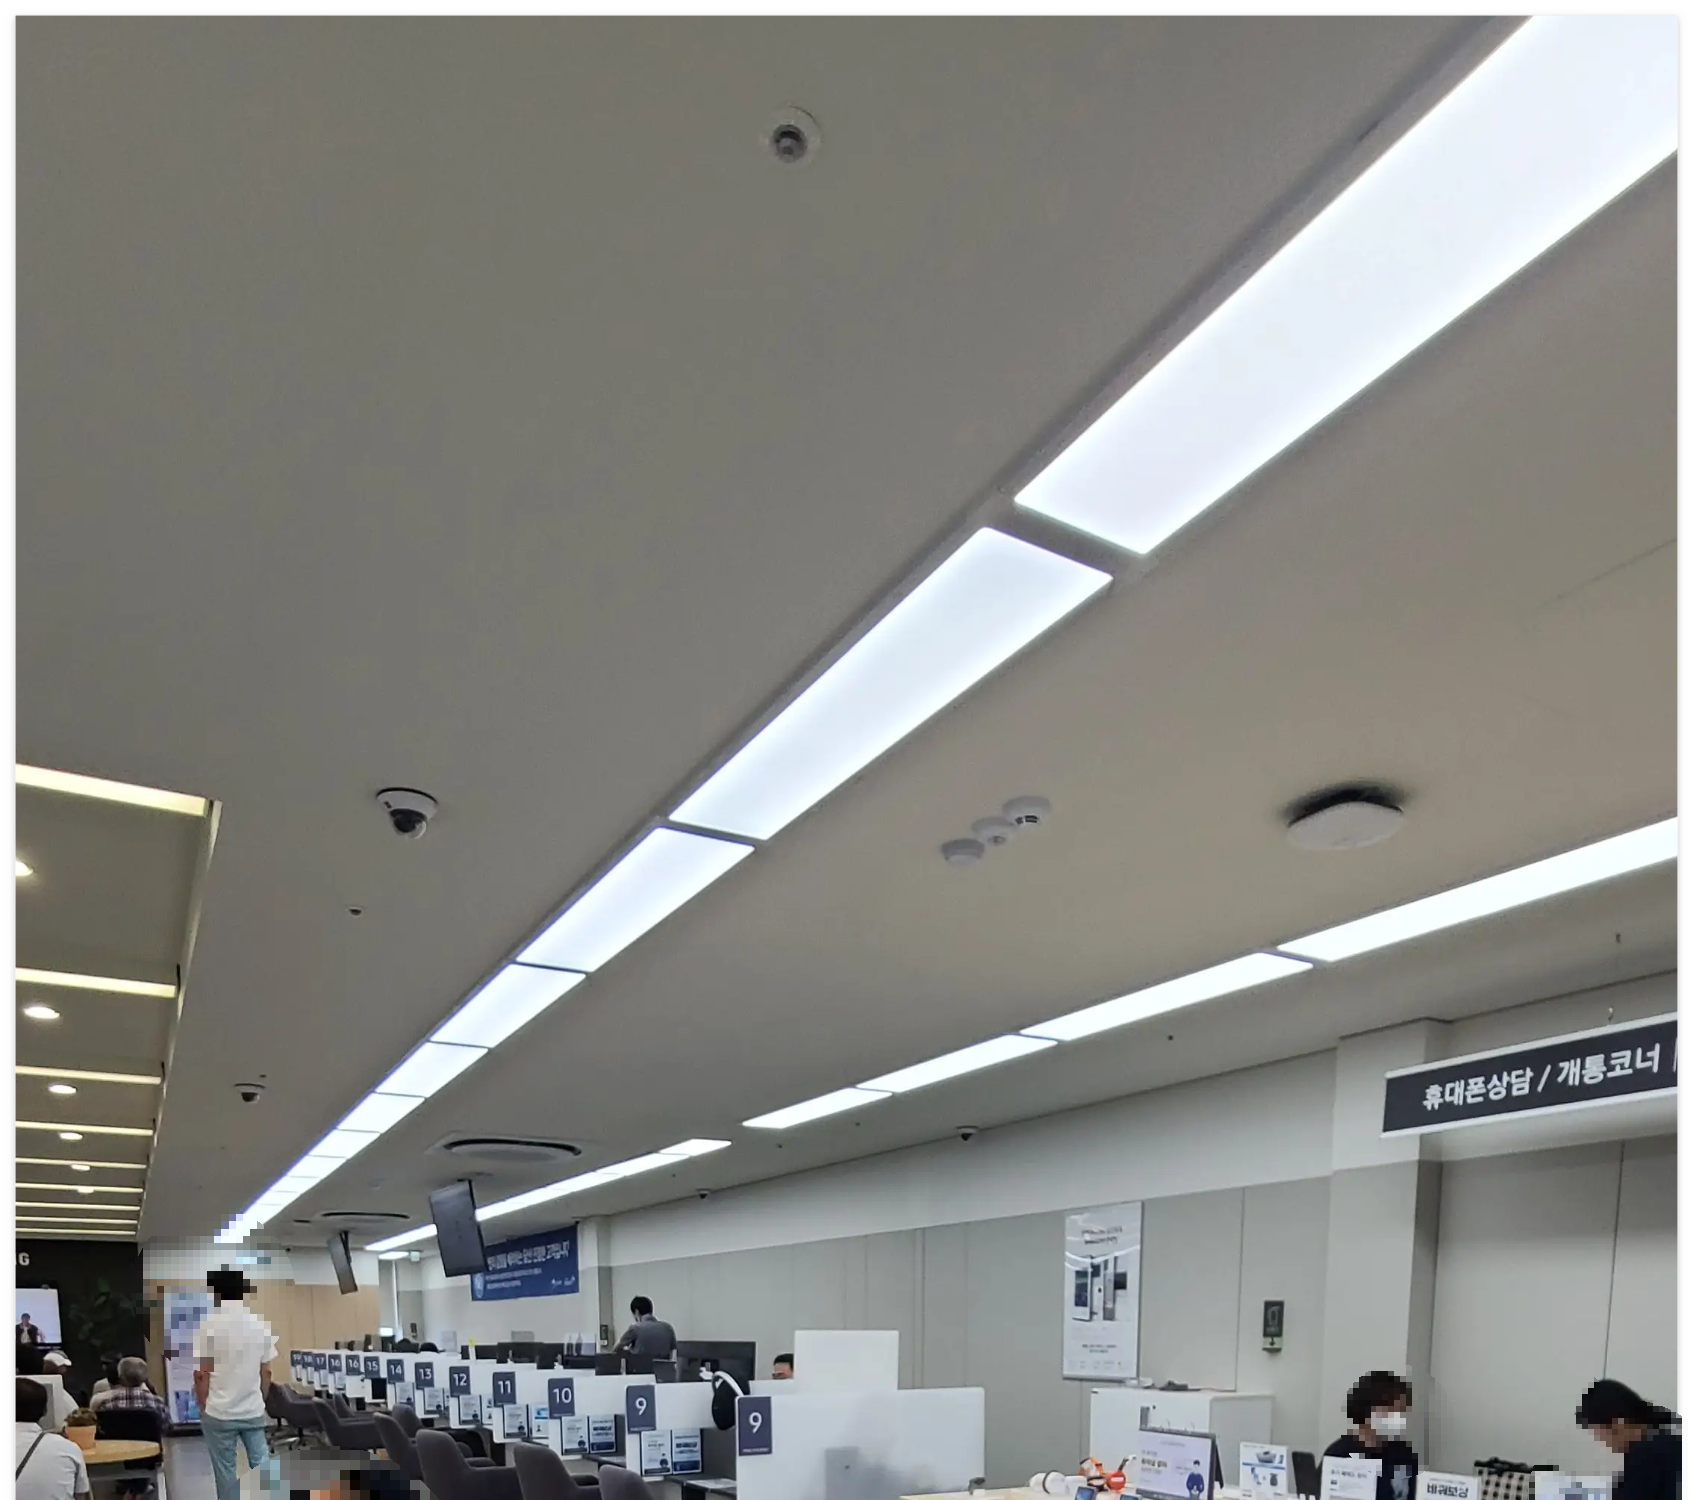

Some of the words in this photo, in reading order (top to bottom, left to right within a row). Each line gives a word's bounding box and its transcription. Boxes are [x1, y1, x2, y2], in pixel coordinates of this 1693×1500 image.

[1422, 1066, 1534, 1111] 휴대폰상담
[1556, 1042, 1661, 1087] 개통코너
[347, 1358, 359, 1369] 16
[366, 1361, 379, 1372] 15
[389, 1364, 403, 1376] 14
[418, 1368, 432, 1380] 13
[452, 1373, 468, 1387] 12
[497, 1380, 512, 1395] 11
[552, 1387, 573, 1404] 10
[634, 1397, 648, 1416] 9
[748, 1411, 763, 1434] 9
